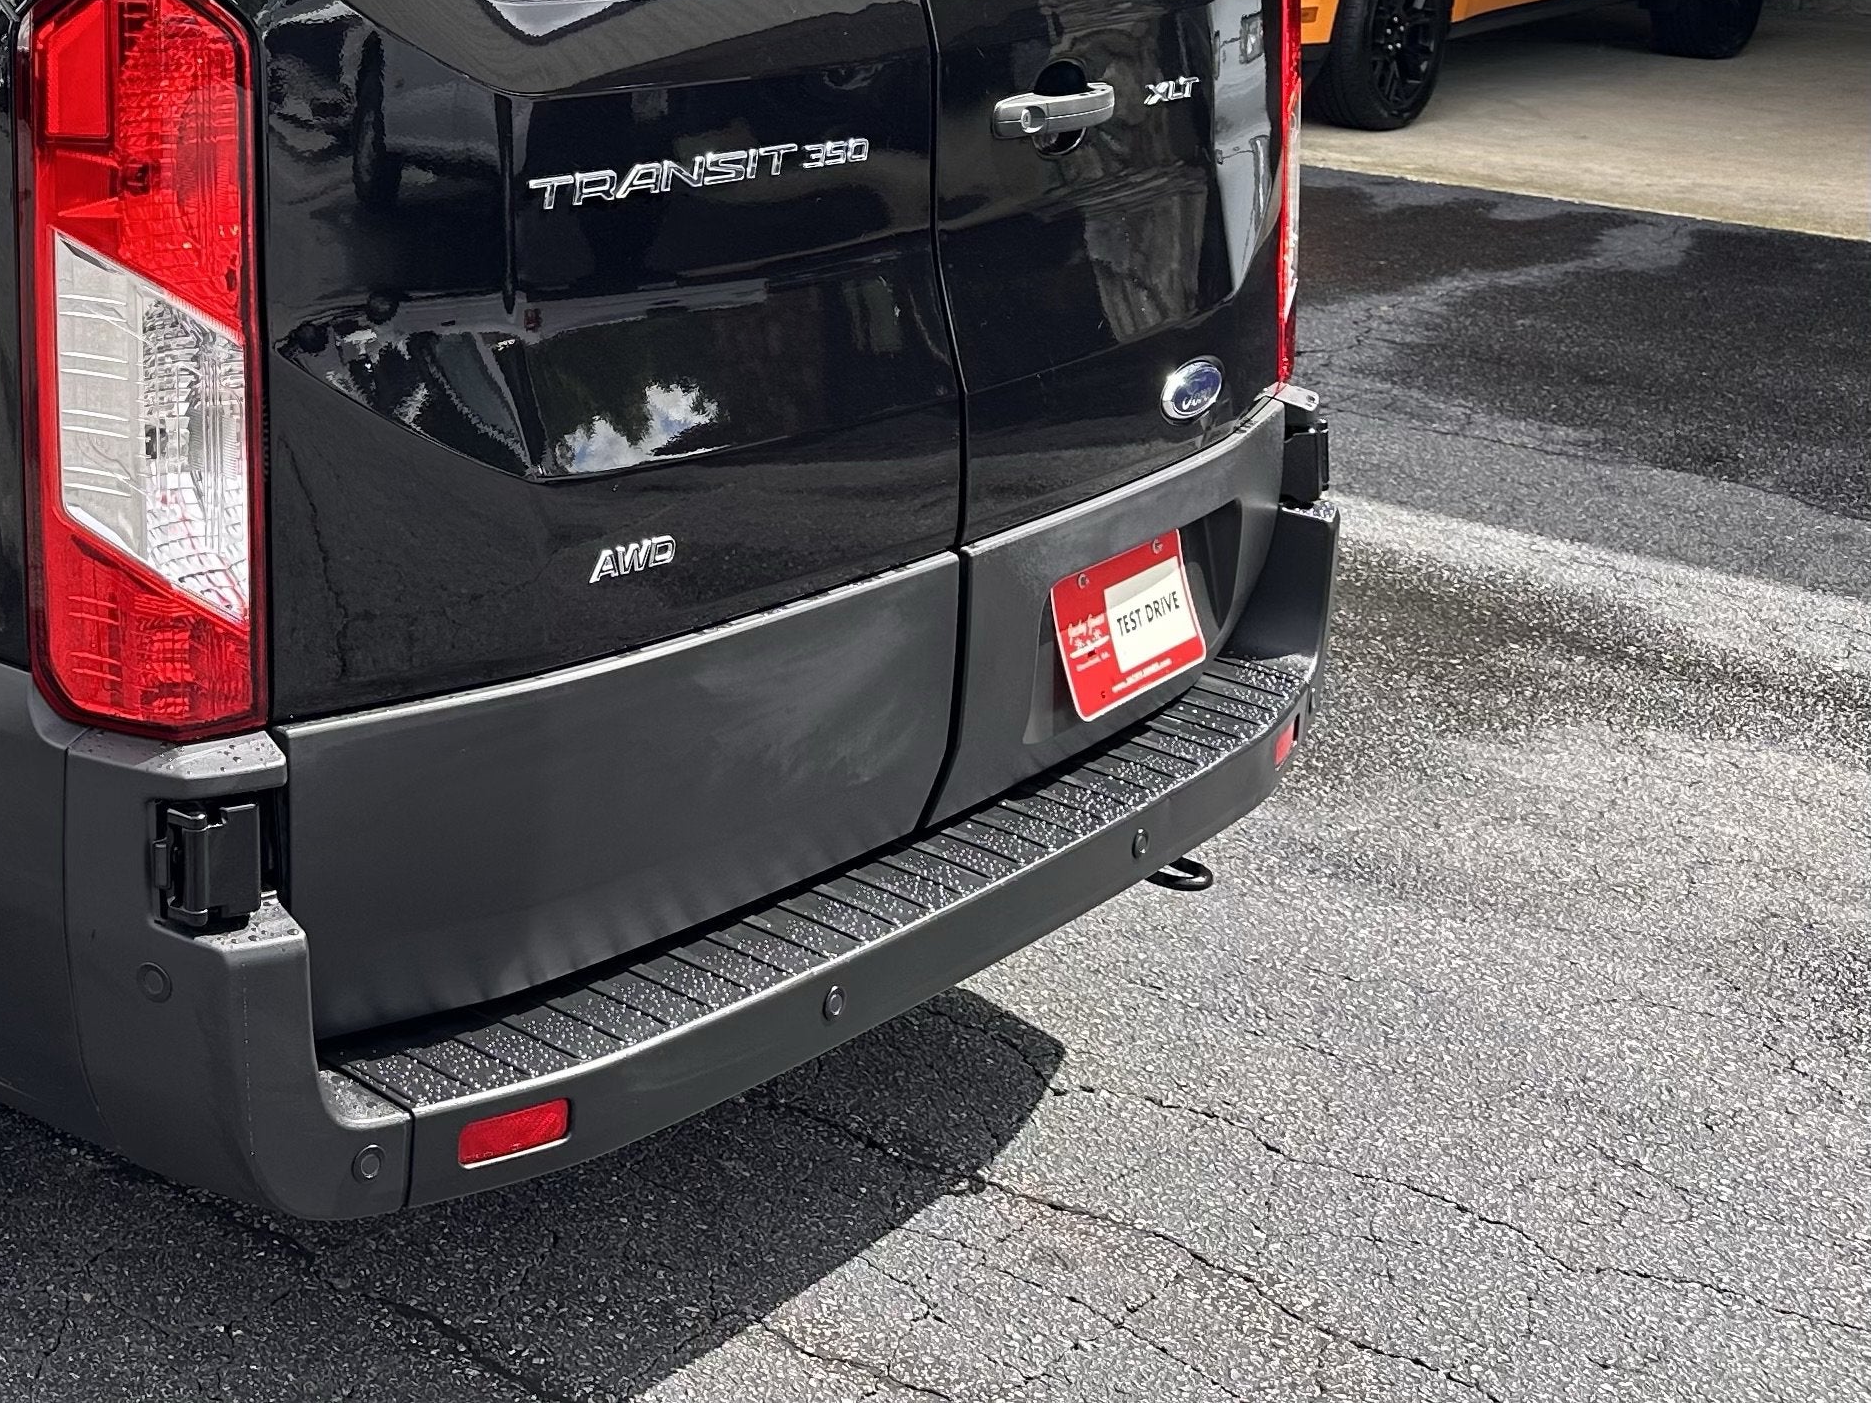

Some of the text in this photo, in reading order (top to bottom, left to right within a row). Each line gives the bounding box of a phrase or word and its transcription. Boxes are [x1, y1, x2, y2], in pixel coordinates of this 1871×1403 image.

[1143, 76, 1200, 105] XLT
[528, 138, 870, 210] TRANSIT 350
[589, 535, 676, 584] AWD
[1116, 608, 1143, 637] TEST
[1145, 591, 1180, 623] DRIVE
